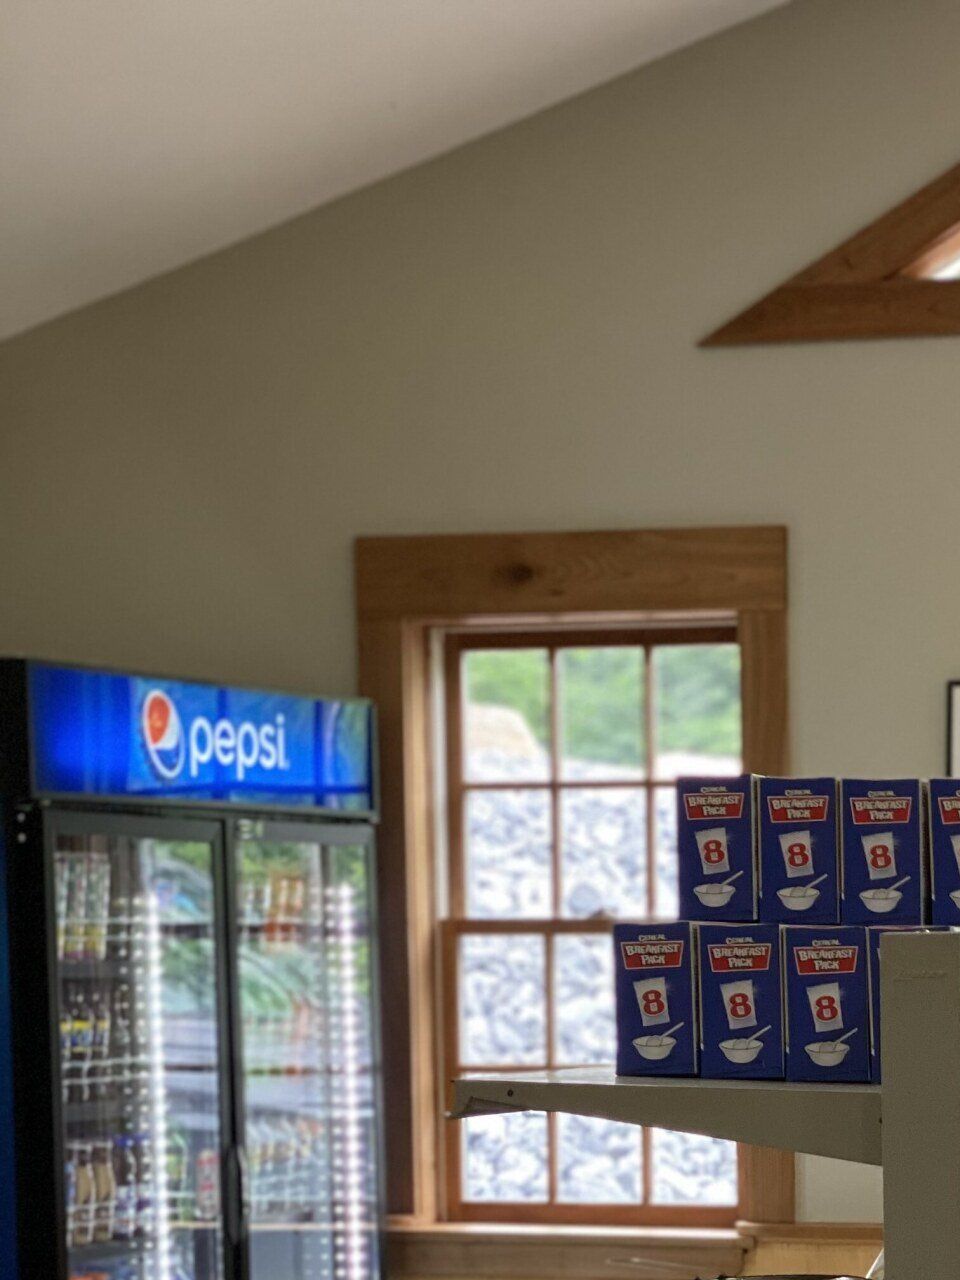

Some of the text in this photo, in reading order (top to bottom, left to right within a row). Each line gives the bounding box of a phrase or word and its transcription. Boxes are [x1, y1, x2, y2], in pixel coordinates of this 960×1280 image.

[190, 713, 286, 781] pepsi
[703, 839, 725, 864] 8
[787, 842, 809, 867] 8
[870, 844, 892, 869] 8
[625, 944, 680, 956] BREAKFAST
[641, 953, 665, 965] PACK
[712, 946, 768, 959] BREAKFAST
[728, 956, 753, 968] PACK
[798, 949, 854, 961] BREAKFAST
[814, 959, 839, 971] PACK
[642, 989, 665, 1016] 8
[728, 992, 752, 1019] 8
[815, 995, 839, 1021] 8
